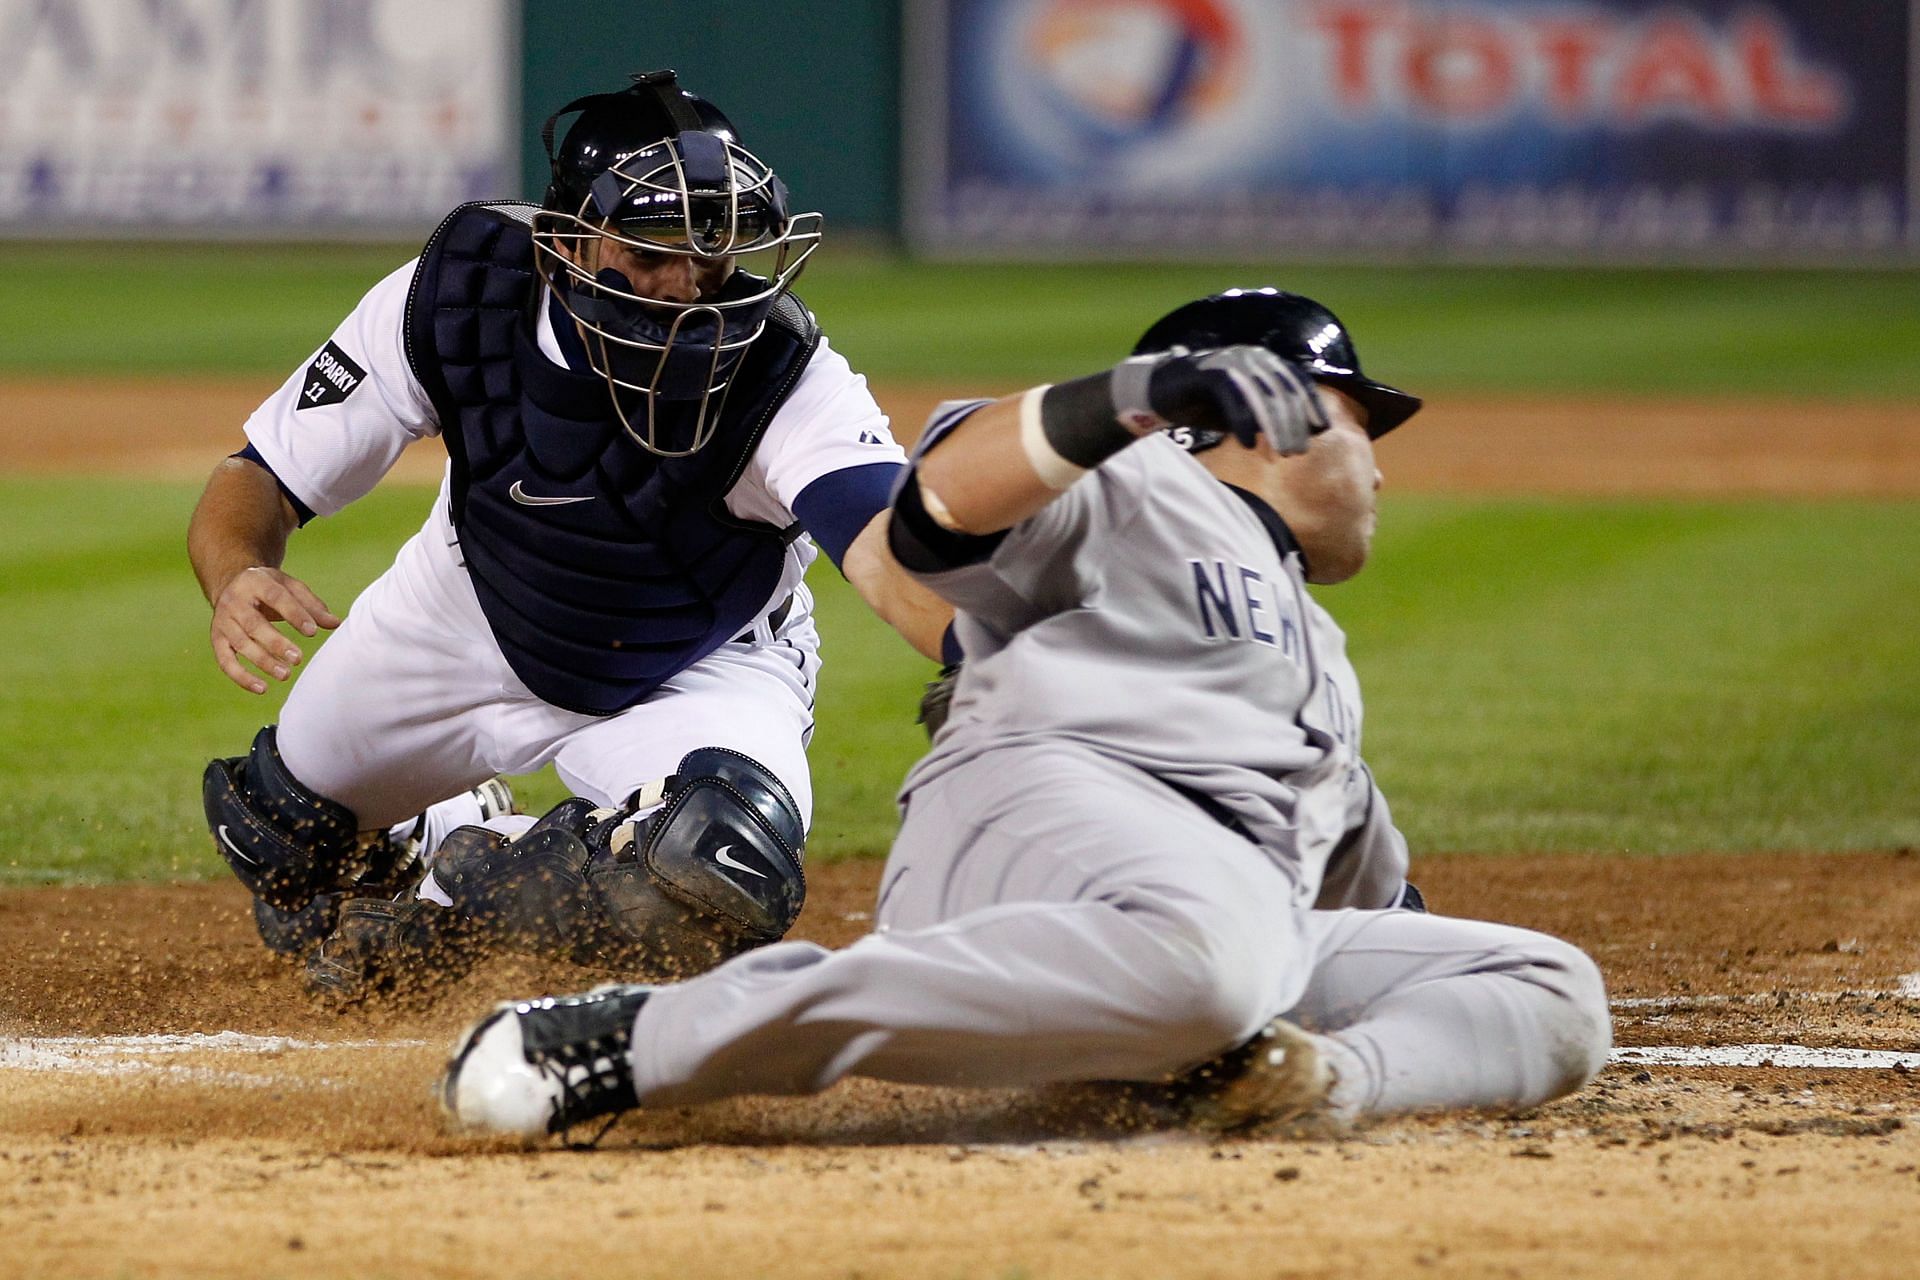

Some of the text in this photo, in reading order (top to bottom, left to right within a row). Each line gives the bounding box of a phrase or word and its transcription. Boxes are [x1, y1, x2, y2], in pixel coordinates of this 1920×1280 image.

[1312, 4, 1842, 124] TOTAL
[305, 382, 326, 402] 11
[316, 352, 357, 392] SPARKY
